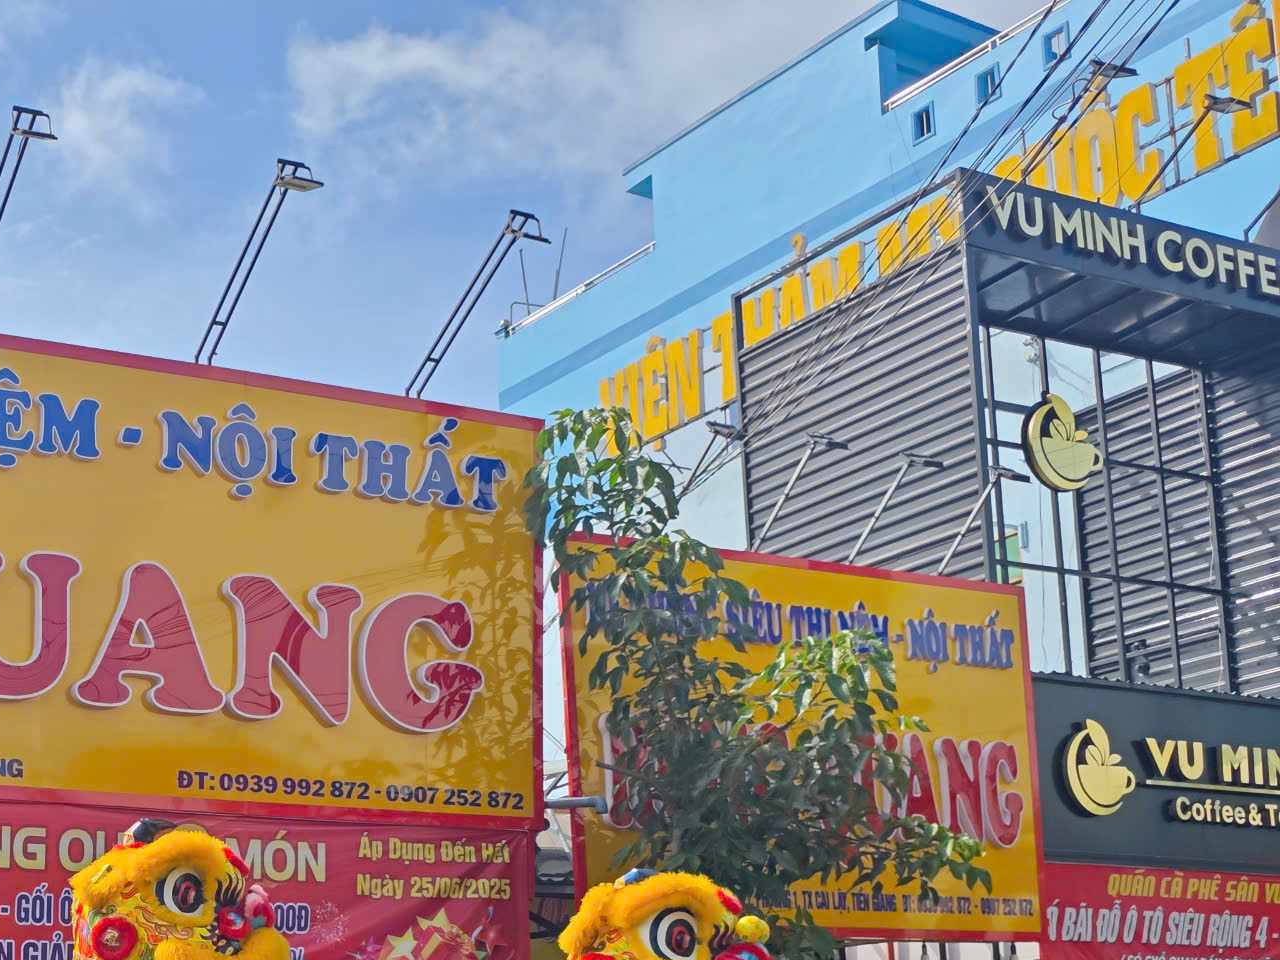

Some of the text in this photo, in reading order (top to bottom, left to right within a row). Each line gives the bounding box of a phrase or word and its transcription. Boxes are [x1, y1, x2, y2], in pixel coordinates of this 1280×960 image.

[994, 75, 1165, 208] UỐC
[986, 185, 1043, 237] VU
[1052, 203, 1146, 264] MINH
[118, 426, 142, 447] -
[159, 402, 299, 498] NỘI
[310, 417, 508, 512] THẤT
[905, 608, 950, 673] NỘI
[950, 609, 1015, 669] THẤT
[1146, 737, 1204, 780] VU
[177, 770, 215, 792] ĐT:
[219, 773, 278, 795] 0939
[282, 777, 325, 798] 992
[330, 780, 370, 800] 872
[386, 784, 438, 805] 0907
[443, 788, 482, 807] 252
[487, 791, 525, 810] 872
[225, 830, 326, 882] MÓN
[358, 832, 510, 865] Áp Dụng Đến Hết
[15, 883, 54, 926] GỐI
[270, 902, 311, 935] 00Đ
[356, 873, 511, 900] Ngày 25/06/2025
[1108, 869, 1259, 903] QUÁN CÀ PHÊ SÂN
[1062, 902, 1093, 942] BÃI
[1096, 900, 1122, 943] ĐỖ
[1123, 904, 1138, 944] Ô
[1141, 905, 1164, 945] TÔ
[1165, 907, 1206, 947] SIÊU
[1206, 909, 1254, 954] RỘNG
[1255, 916, 1269, 948] 4
